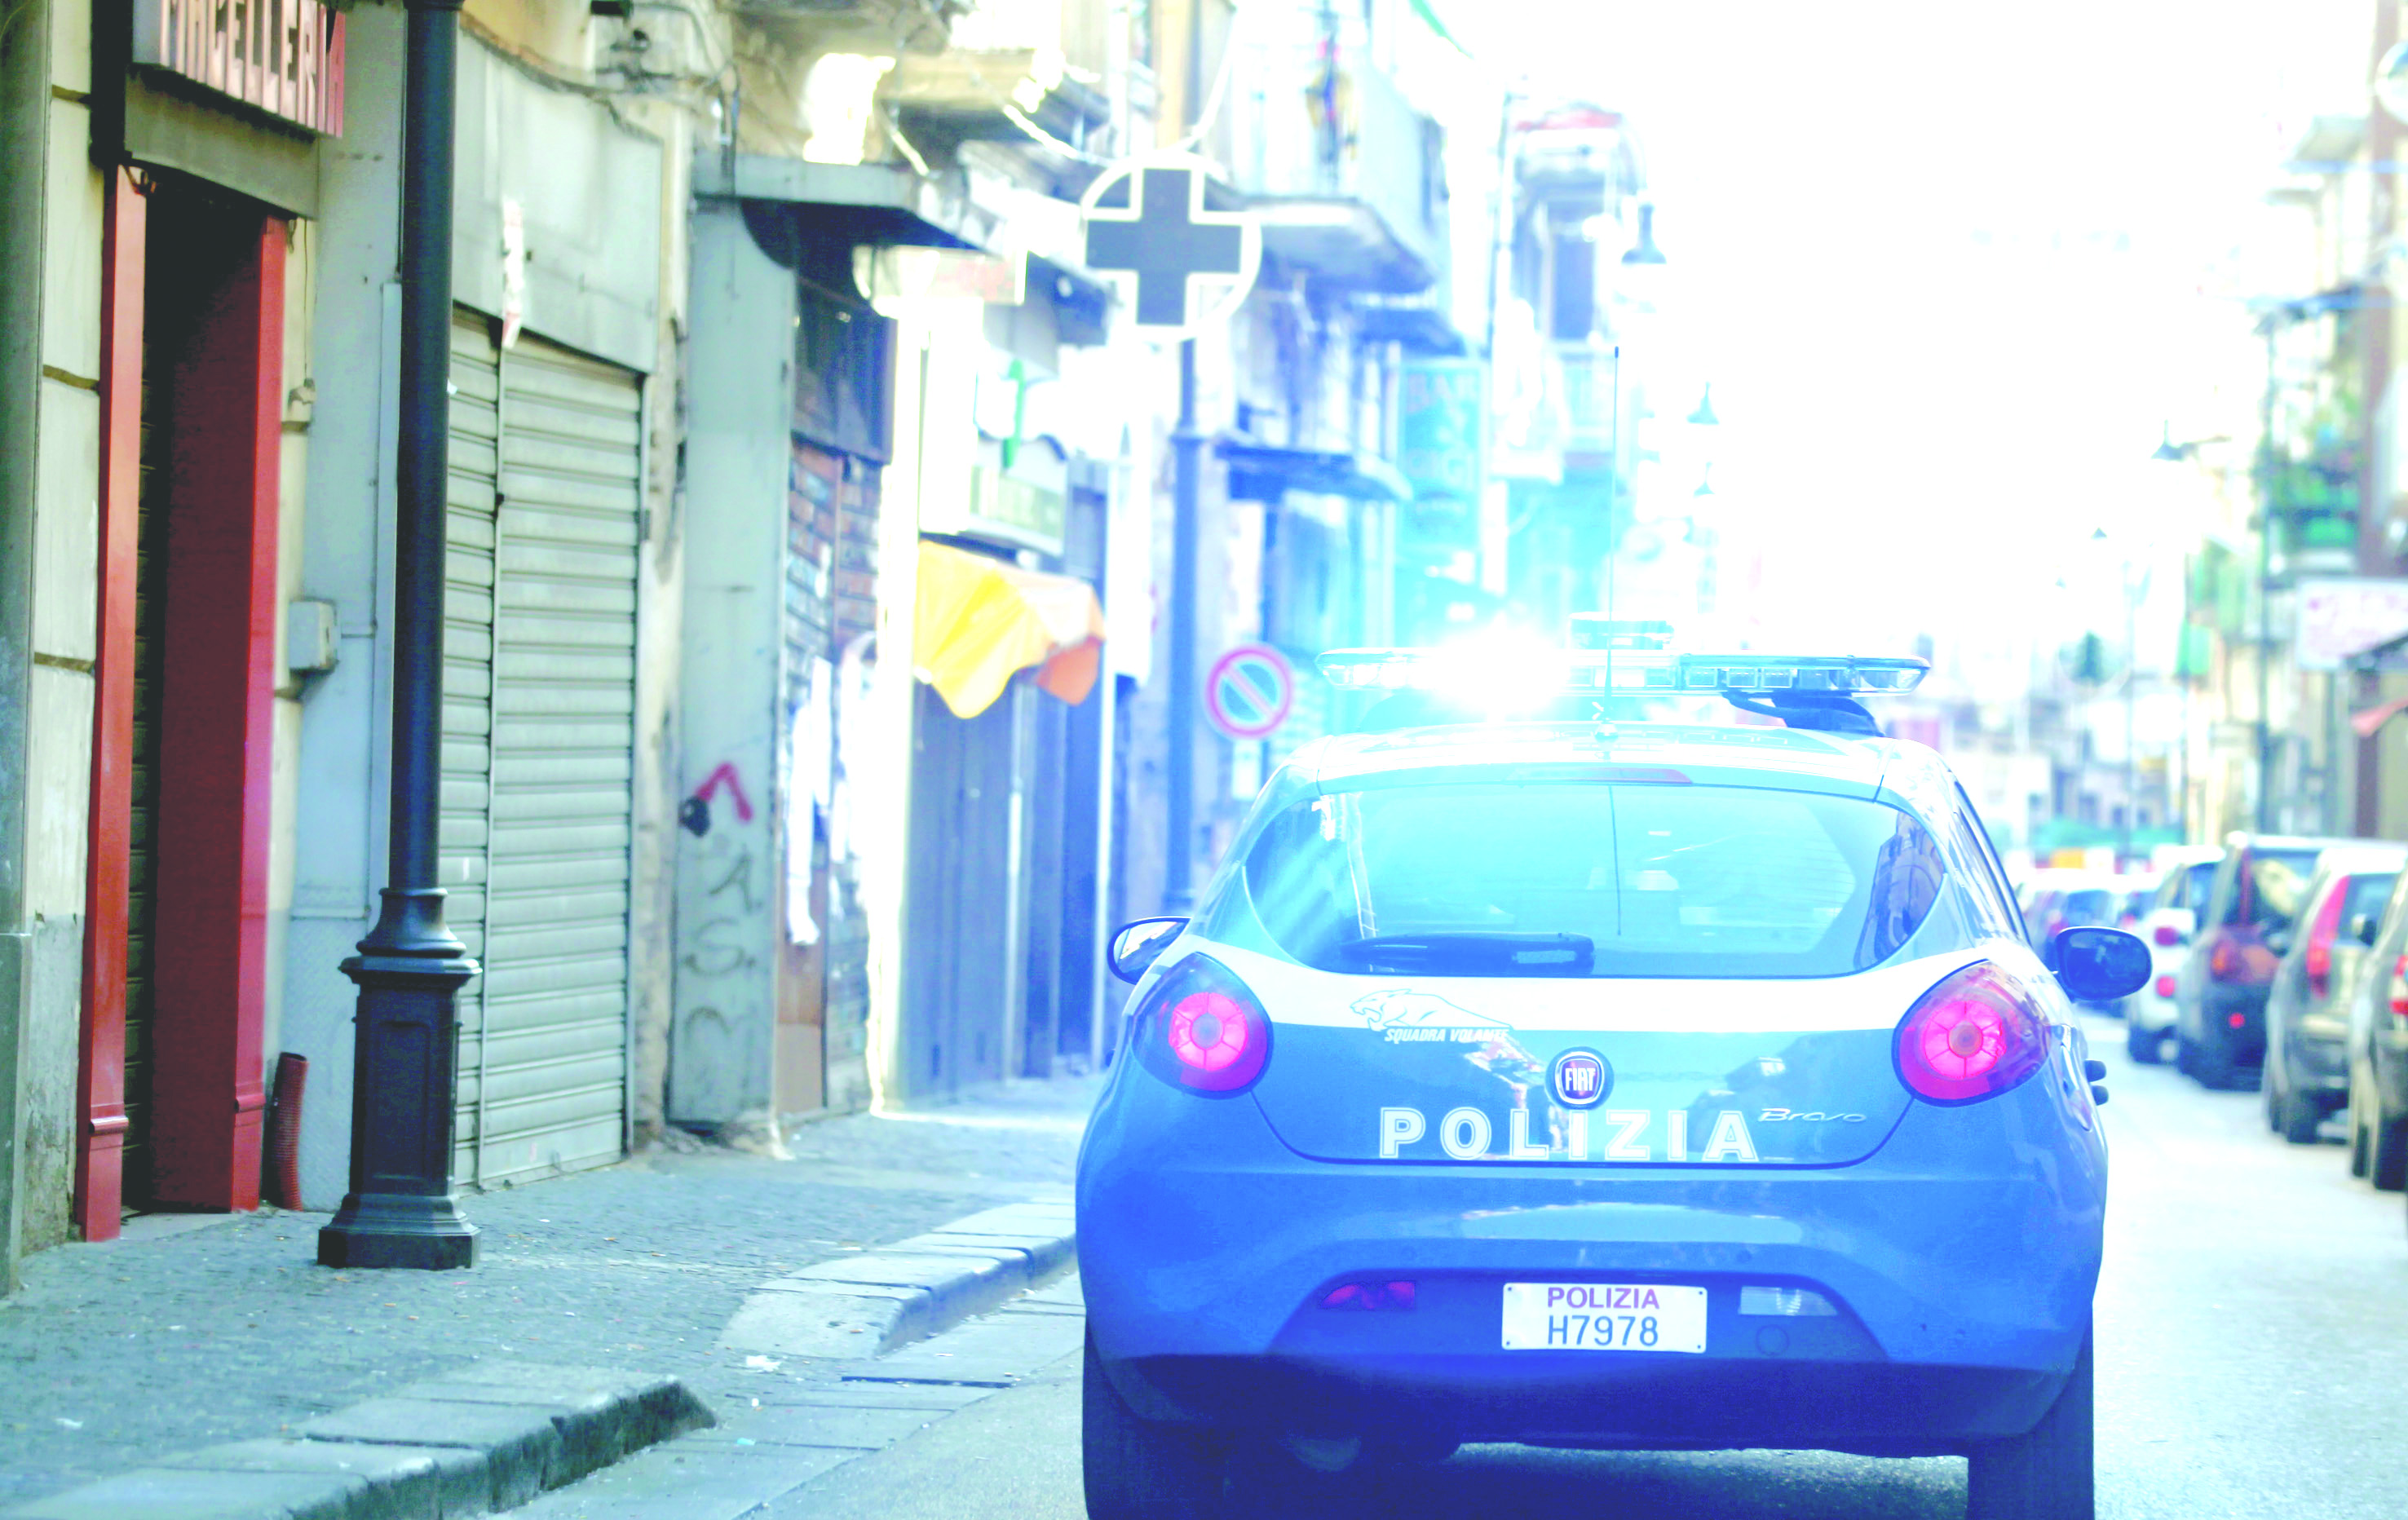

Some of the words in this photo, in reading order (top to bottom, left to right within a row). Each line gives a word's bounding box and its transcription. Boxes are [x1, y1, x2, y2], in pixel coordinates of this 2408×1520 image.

[1384, 1028, 1446, 1044] SQUADRA
[1565, 1067, 1596, 1091] FIAT
[1758, 1107, 1867, 1122] Bravo
[1380, 1107, 1760, 1162] POLIZIA
[1548, 1287, 1660, 1310] POLIZIA
[1548, 1315, 1659, 1346] H7978
